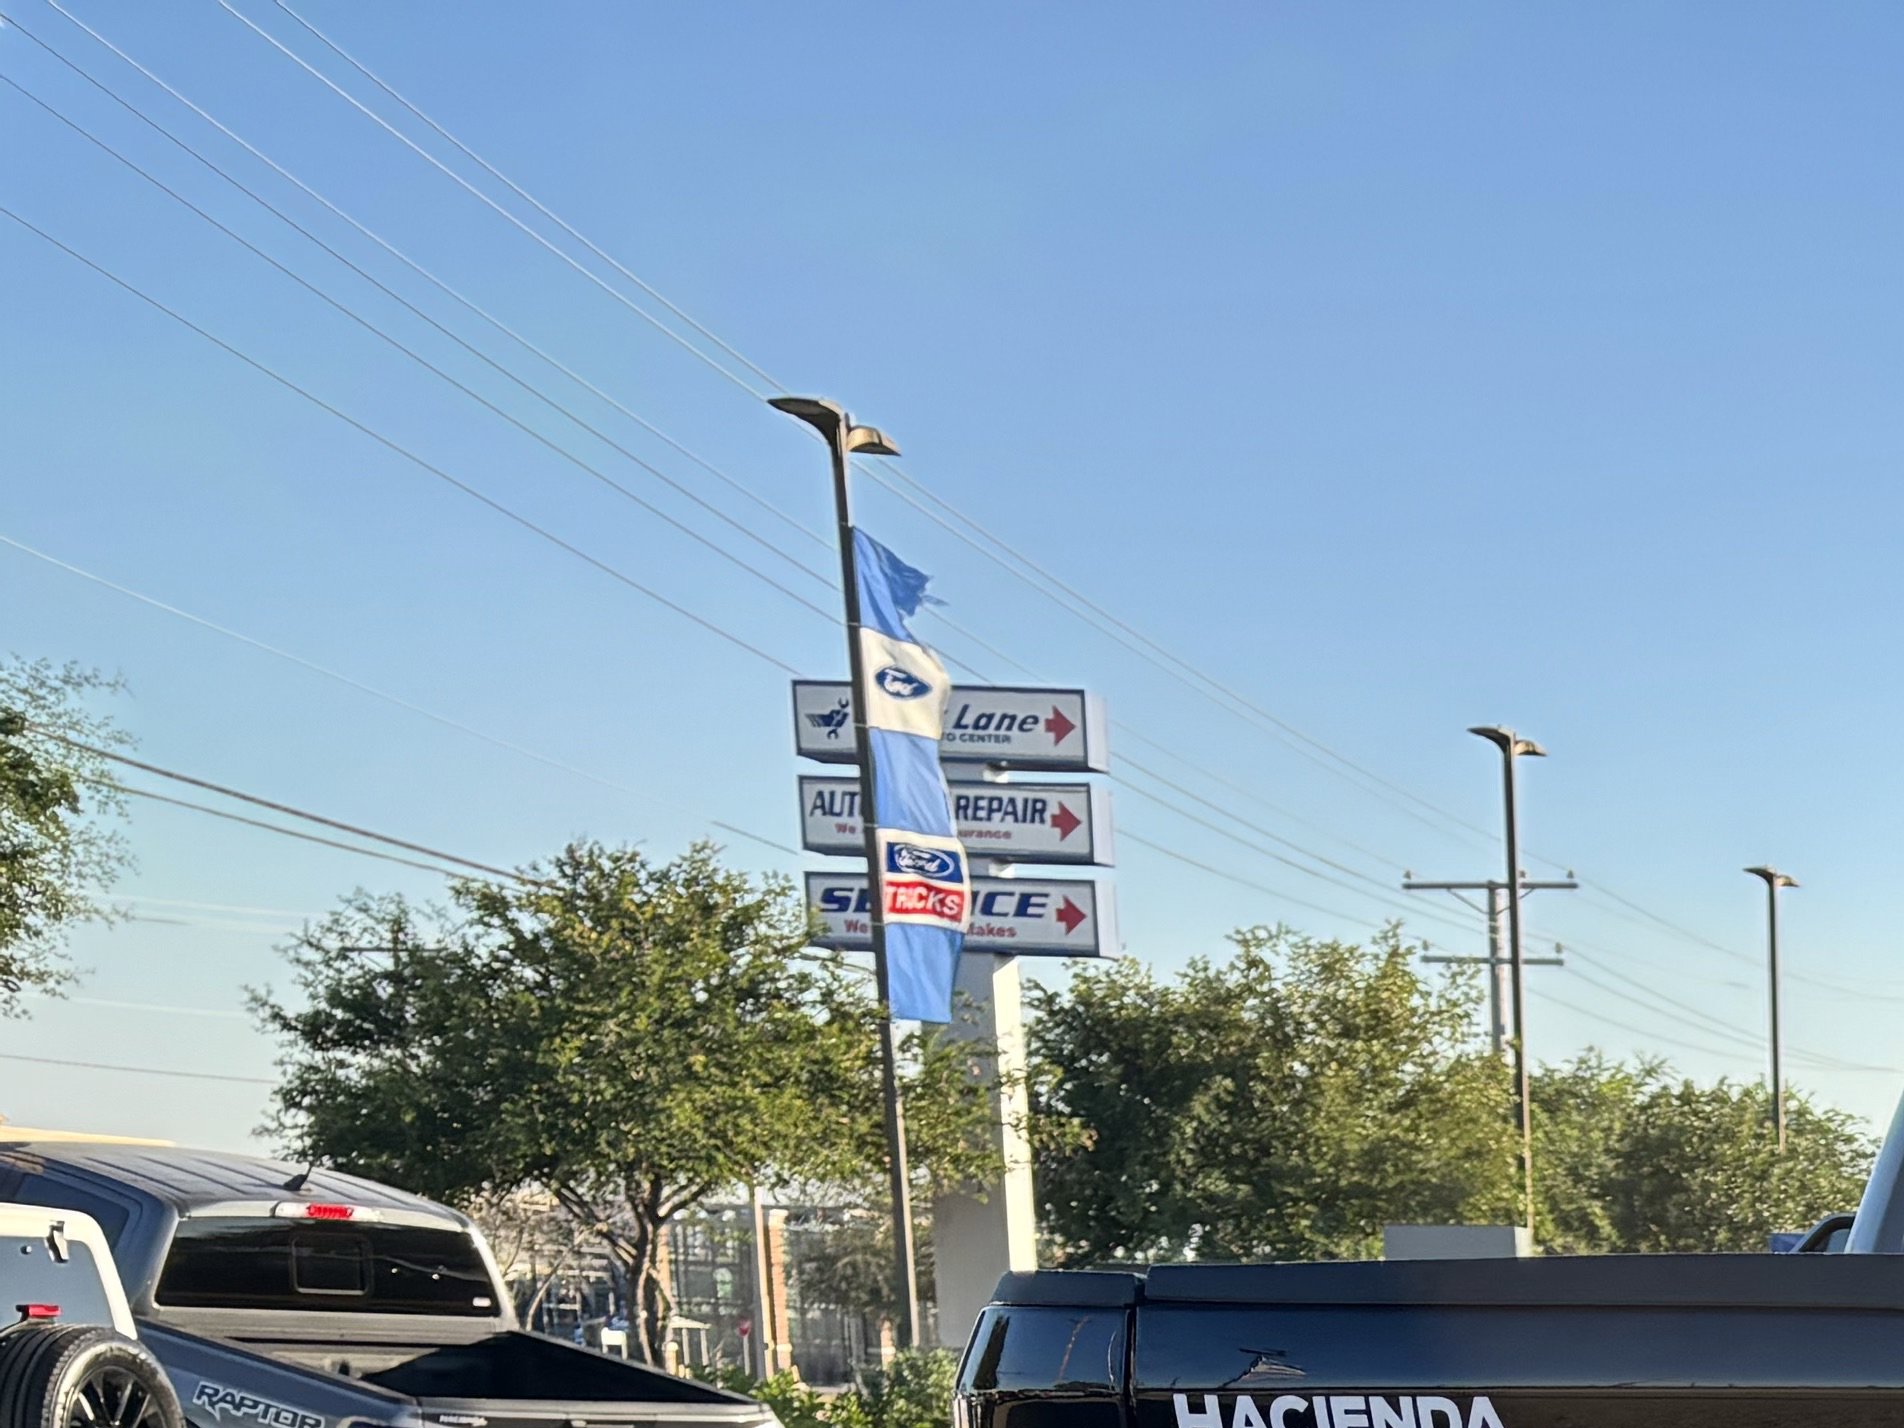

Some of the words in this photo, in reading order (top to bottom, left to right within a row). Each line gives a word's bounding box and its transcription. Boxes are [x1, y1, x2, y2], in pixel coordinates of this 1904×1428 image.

[952, 703, 1039, 732] Lane
[809, 791, 861, 817] AUT
[955, 795, 1047, 824] REPAIR
